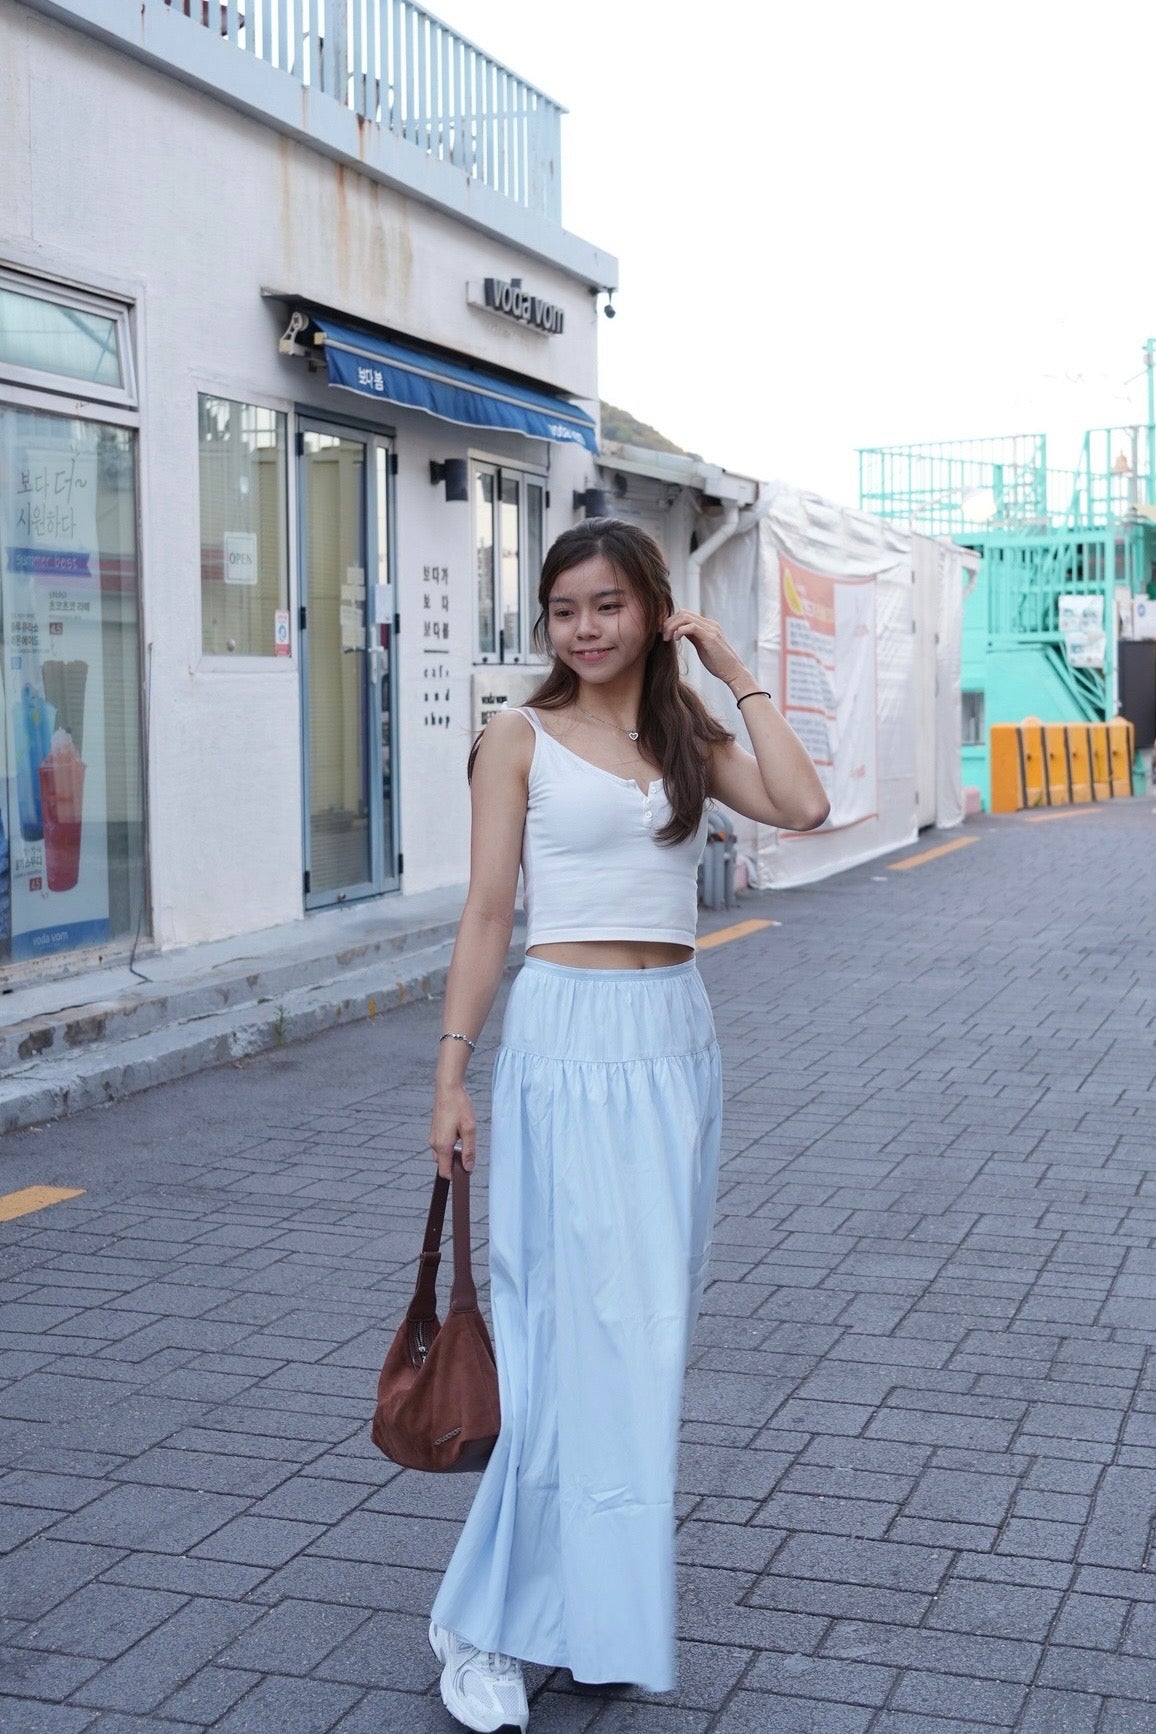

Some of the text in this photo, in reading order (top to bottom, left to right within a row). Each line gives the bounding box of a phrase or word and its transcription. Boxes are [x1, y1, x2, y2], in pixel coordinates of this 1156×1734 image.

[484, 278, 564, 334] voda vom
[358, 366, 384, 391] 보다봄
[17, 466, 49, 500] 보다
[17, 500, 76, 539] 시원하다
[229, 552, 253, 565] OPEN
